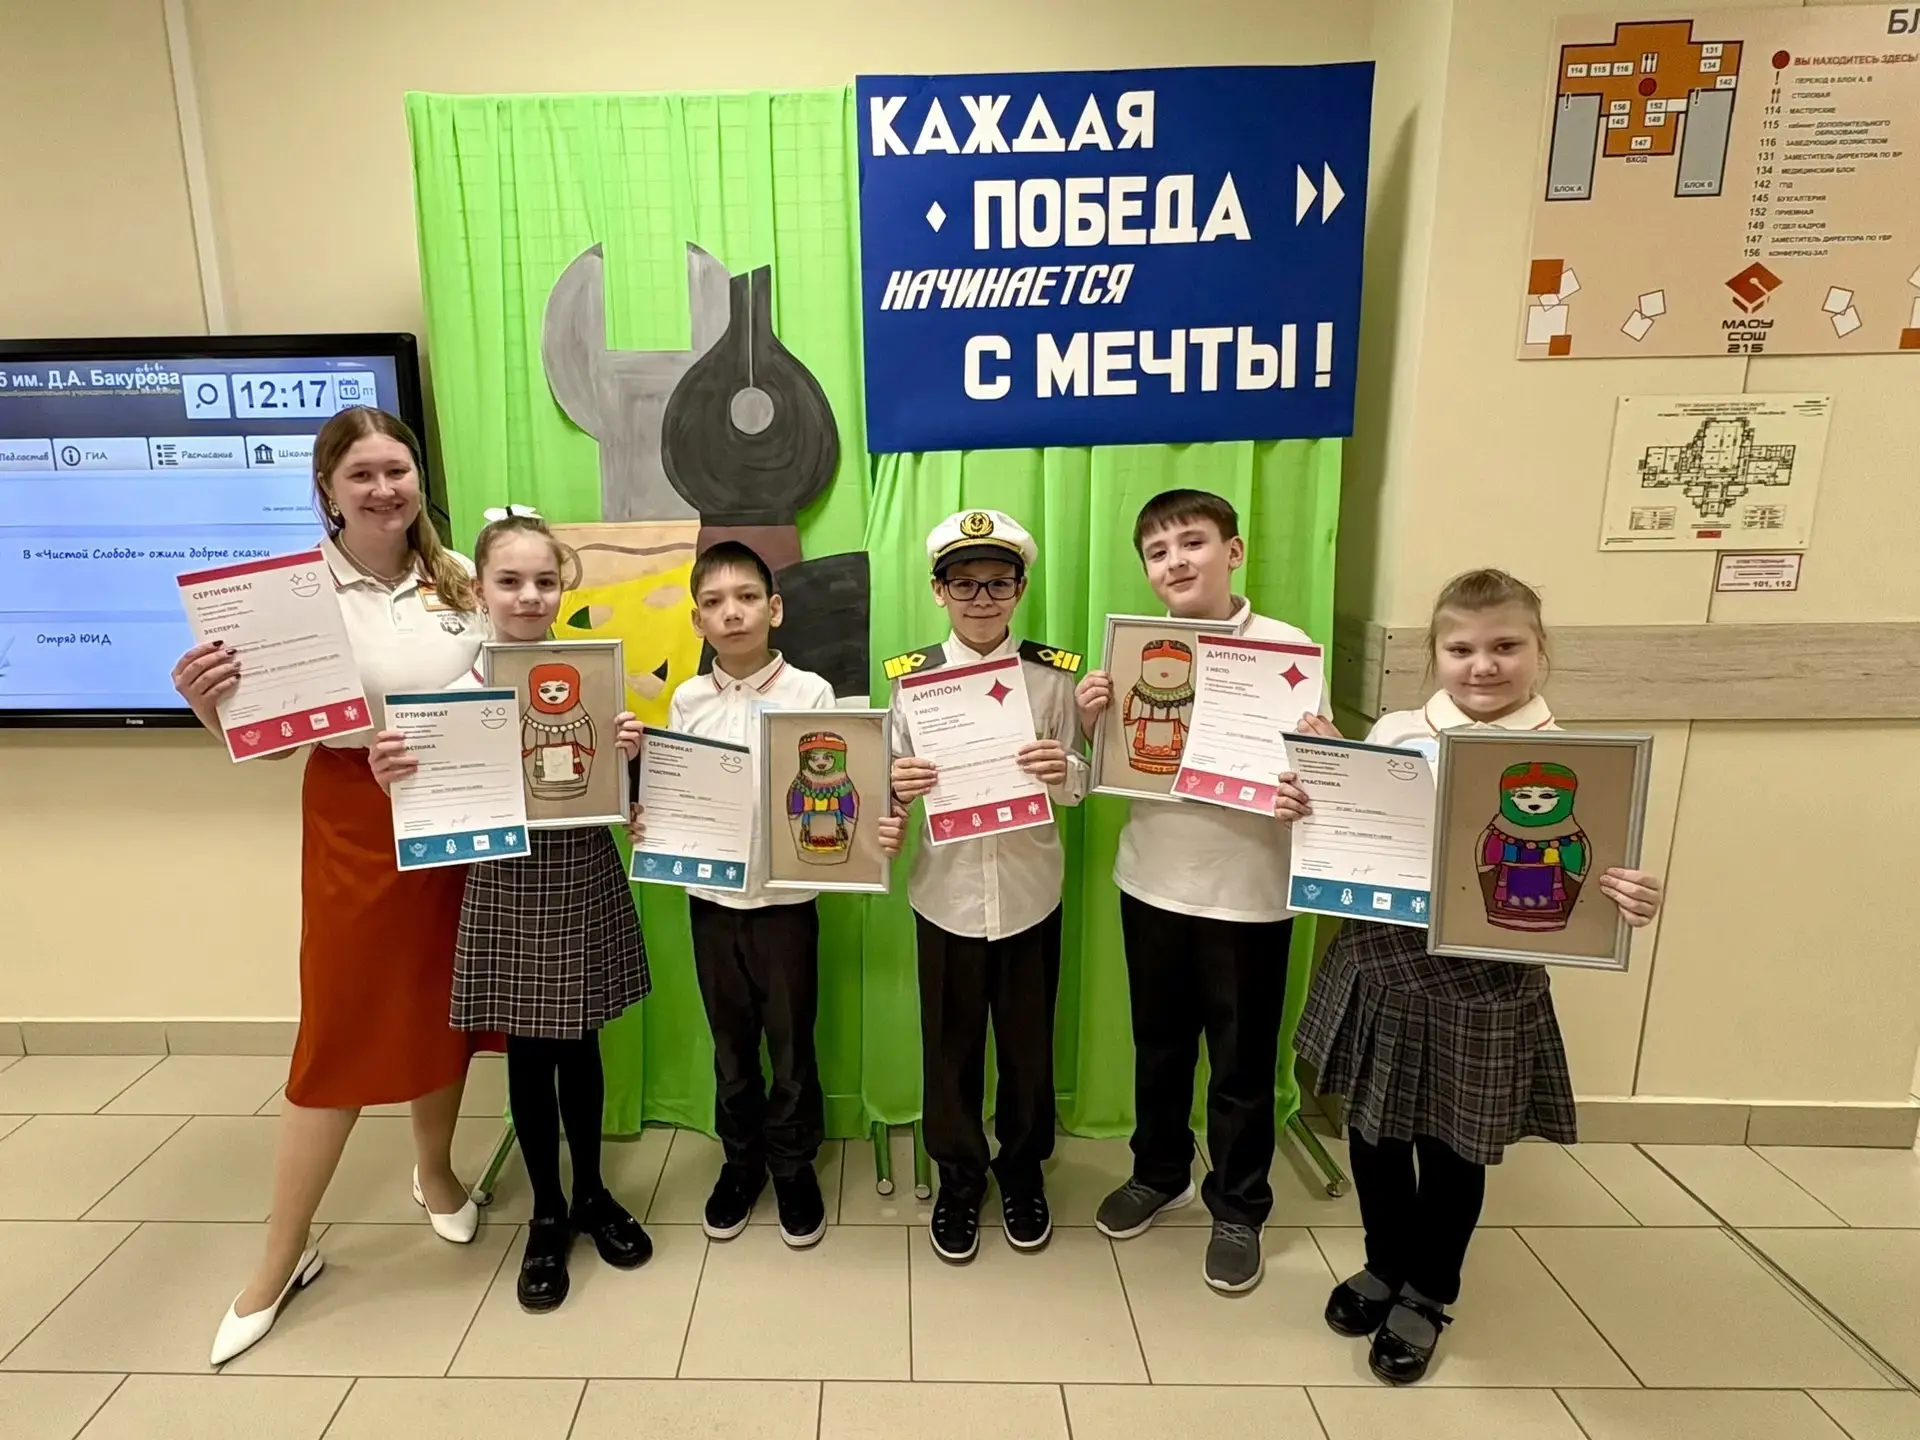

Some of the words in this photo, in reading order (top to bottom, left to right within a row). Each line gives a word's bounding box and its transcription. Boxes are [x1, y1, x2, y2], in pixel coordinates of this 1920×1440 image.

[1705, 46, 1718, 54] 131
[1794, 57, 1810, 66] ВЫ
[1813, 55, 1879, 66] НАХОДИТЕСЬ
[1881, 54, 1919, 64] ЗДЕСЬ!
[1570, 66, 1583, 74] 114
[1593, 65, 1606, 73] 115
[1703, 62, 1716, 70] 134
[1719, 78, 1733, 86] 142
[1613, 103, 1626, 111] 156
[1649, 102, 1662, 110] 152
[1764, 106, 1781, 114] 114
[870, 90, 1155, 156] КАЖДАЯ
[1762, 120, 1779, 129] 115
[1634, 139, 1648, 147] 147
[1759, 138, 1776, 147] 116
[1626, 156, 1648, 164] ВХОД
[1758, 152, 1774, 161] 131
[1756, 166, 1773, 174] 134
[1754, 180, 1771, 188] 142
[1751, 194, 1769, 202] 145
[972, 170, 1252, 250] ПОБЕДА
[1749, 208, 1767, 216] 152
[1747, 222, 1764, 230] 149
[1745, 235, 1762, 243] 147
[1743, 248, 1760, 257] 156
[880, 263, 1135, 310] НАЧИНАЕТСЯ
[1722, 319, 1774, 329] МАОУ
[1727, 331, 1767, 341] СОШ
[1727, 343, 1764, 353] 215
[964, 335, 1012, 400] С
[12, 374, 43, 387] им.
[48, 370, 86, 389] Д.А.
[91, 369, 181, 389] Бакурова
[240, 380, 327, 408] 12:17
[343, 387, 357, 396] 10
[363, 388, 374, 397] ПТ
[85, 452, 108, 460] ГИА
[181, 450, 233, 459] Расписание
[23, 550, 31, 559] В
[36, 549, 88, 560] «Чистой
[93, 549, 145, 559] Слободе»
[149, 550, 185, 559] ожили
[190, 549, 229, 561] добрые
[233, 549, 270, 558] сказки
[193, 582, 253, 600] СЕРТИФИКАТ
[204, 623, 240, 635] ЭКСПЕРТА
[37, 634, 76, 647] Отряд
[81, 634, 111, 645] ЮИД
[1206, 650, 1257, 663] ДИПЛОМ
[912, 684, 962, 702] ДИПЛОМ
[395, 710, 448, 719] СЕРТИФИКАТ
[649, 741, 693, 753] СЕРТИФИКАТ
[1295, 747, 1350, 759] СЕРТИФИКАТ
[1301, 779, 1341, 788] УЧАСТНИКА
